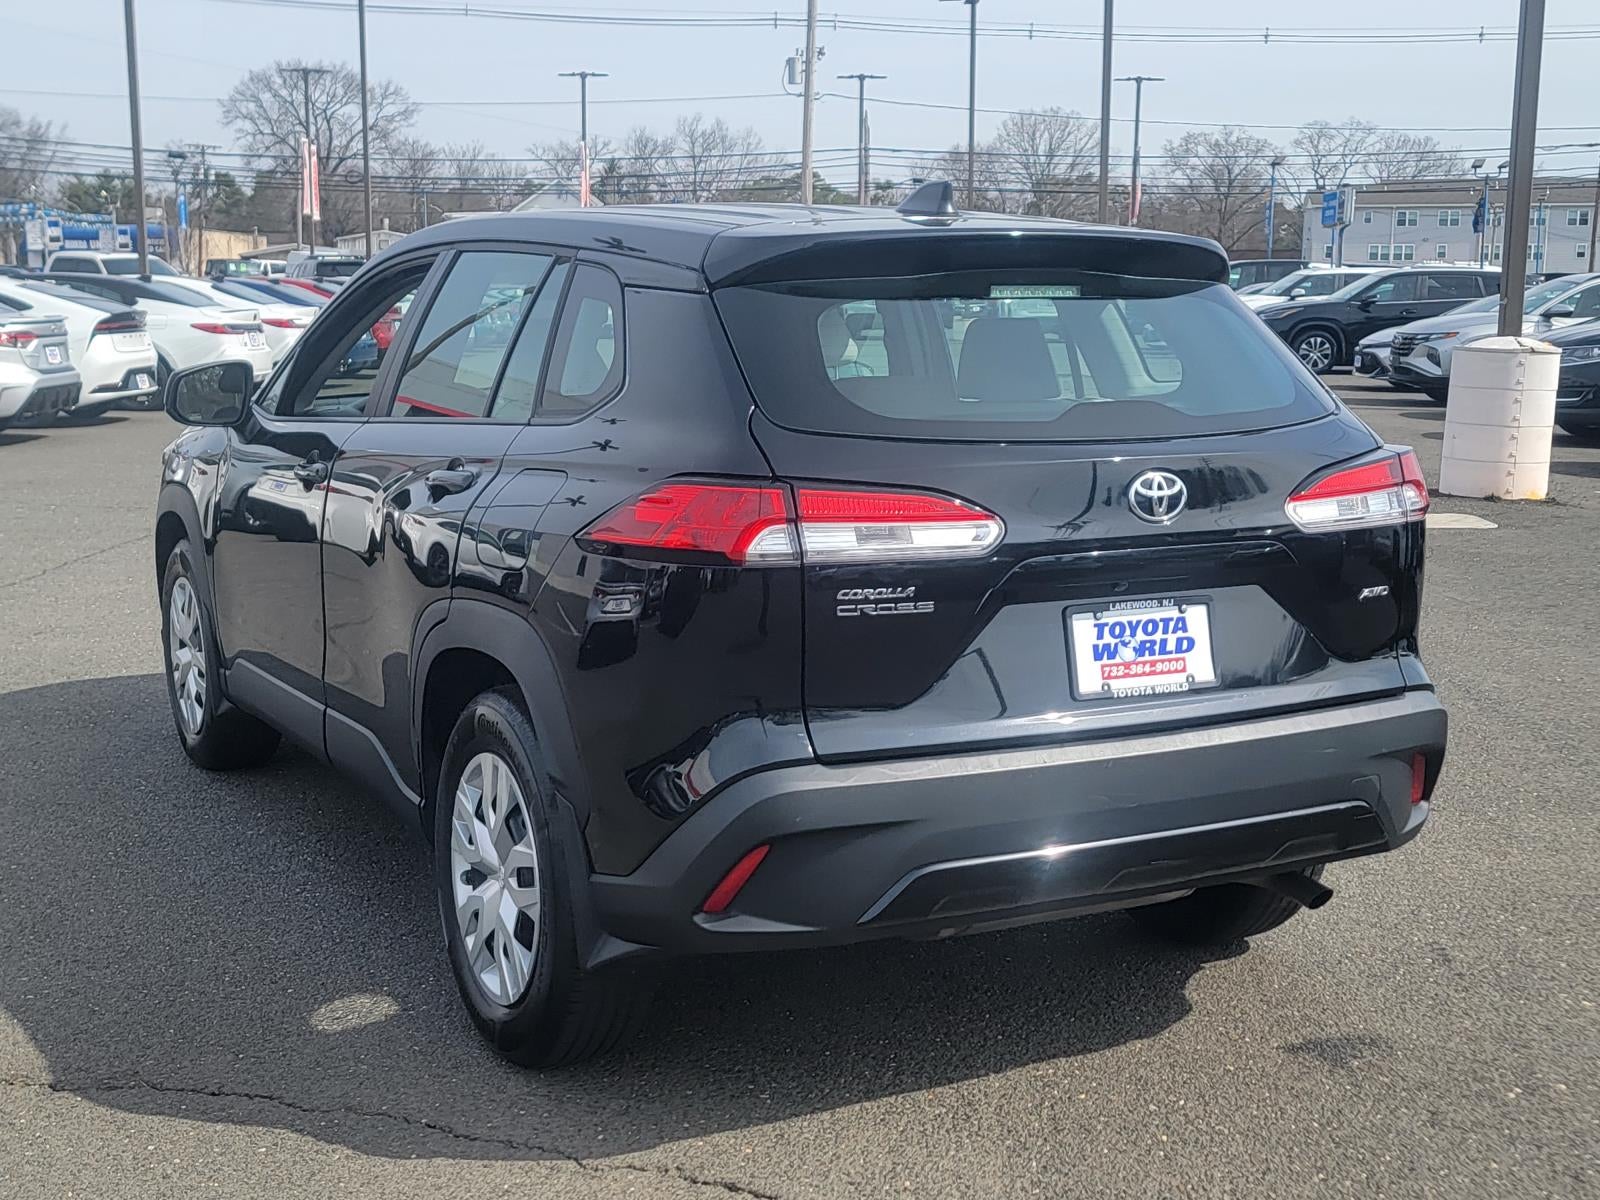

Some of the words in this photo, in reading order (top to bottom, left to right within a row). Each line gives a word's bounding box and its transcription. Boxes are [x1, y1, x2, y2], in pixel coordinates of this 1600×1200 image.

[837, 586, 916, 600] COROLLA
[836, 601, 935, 616] CROSS
[1162, 598, 1174, 607] NJ
[1093, 616, 1189, 640] TOYOTA
[1103, 660, 1185, 677] 732-364-9000
[1111, 686, 1153, 698] TOYOTA
[1154, 682, 1189, 694] WORLD
